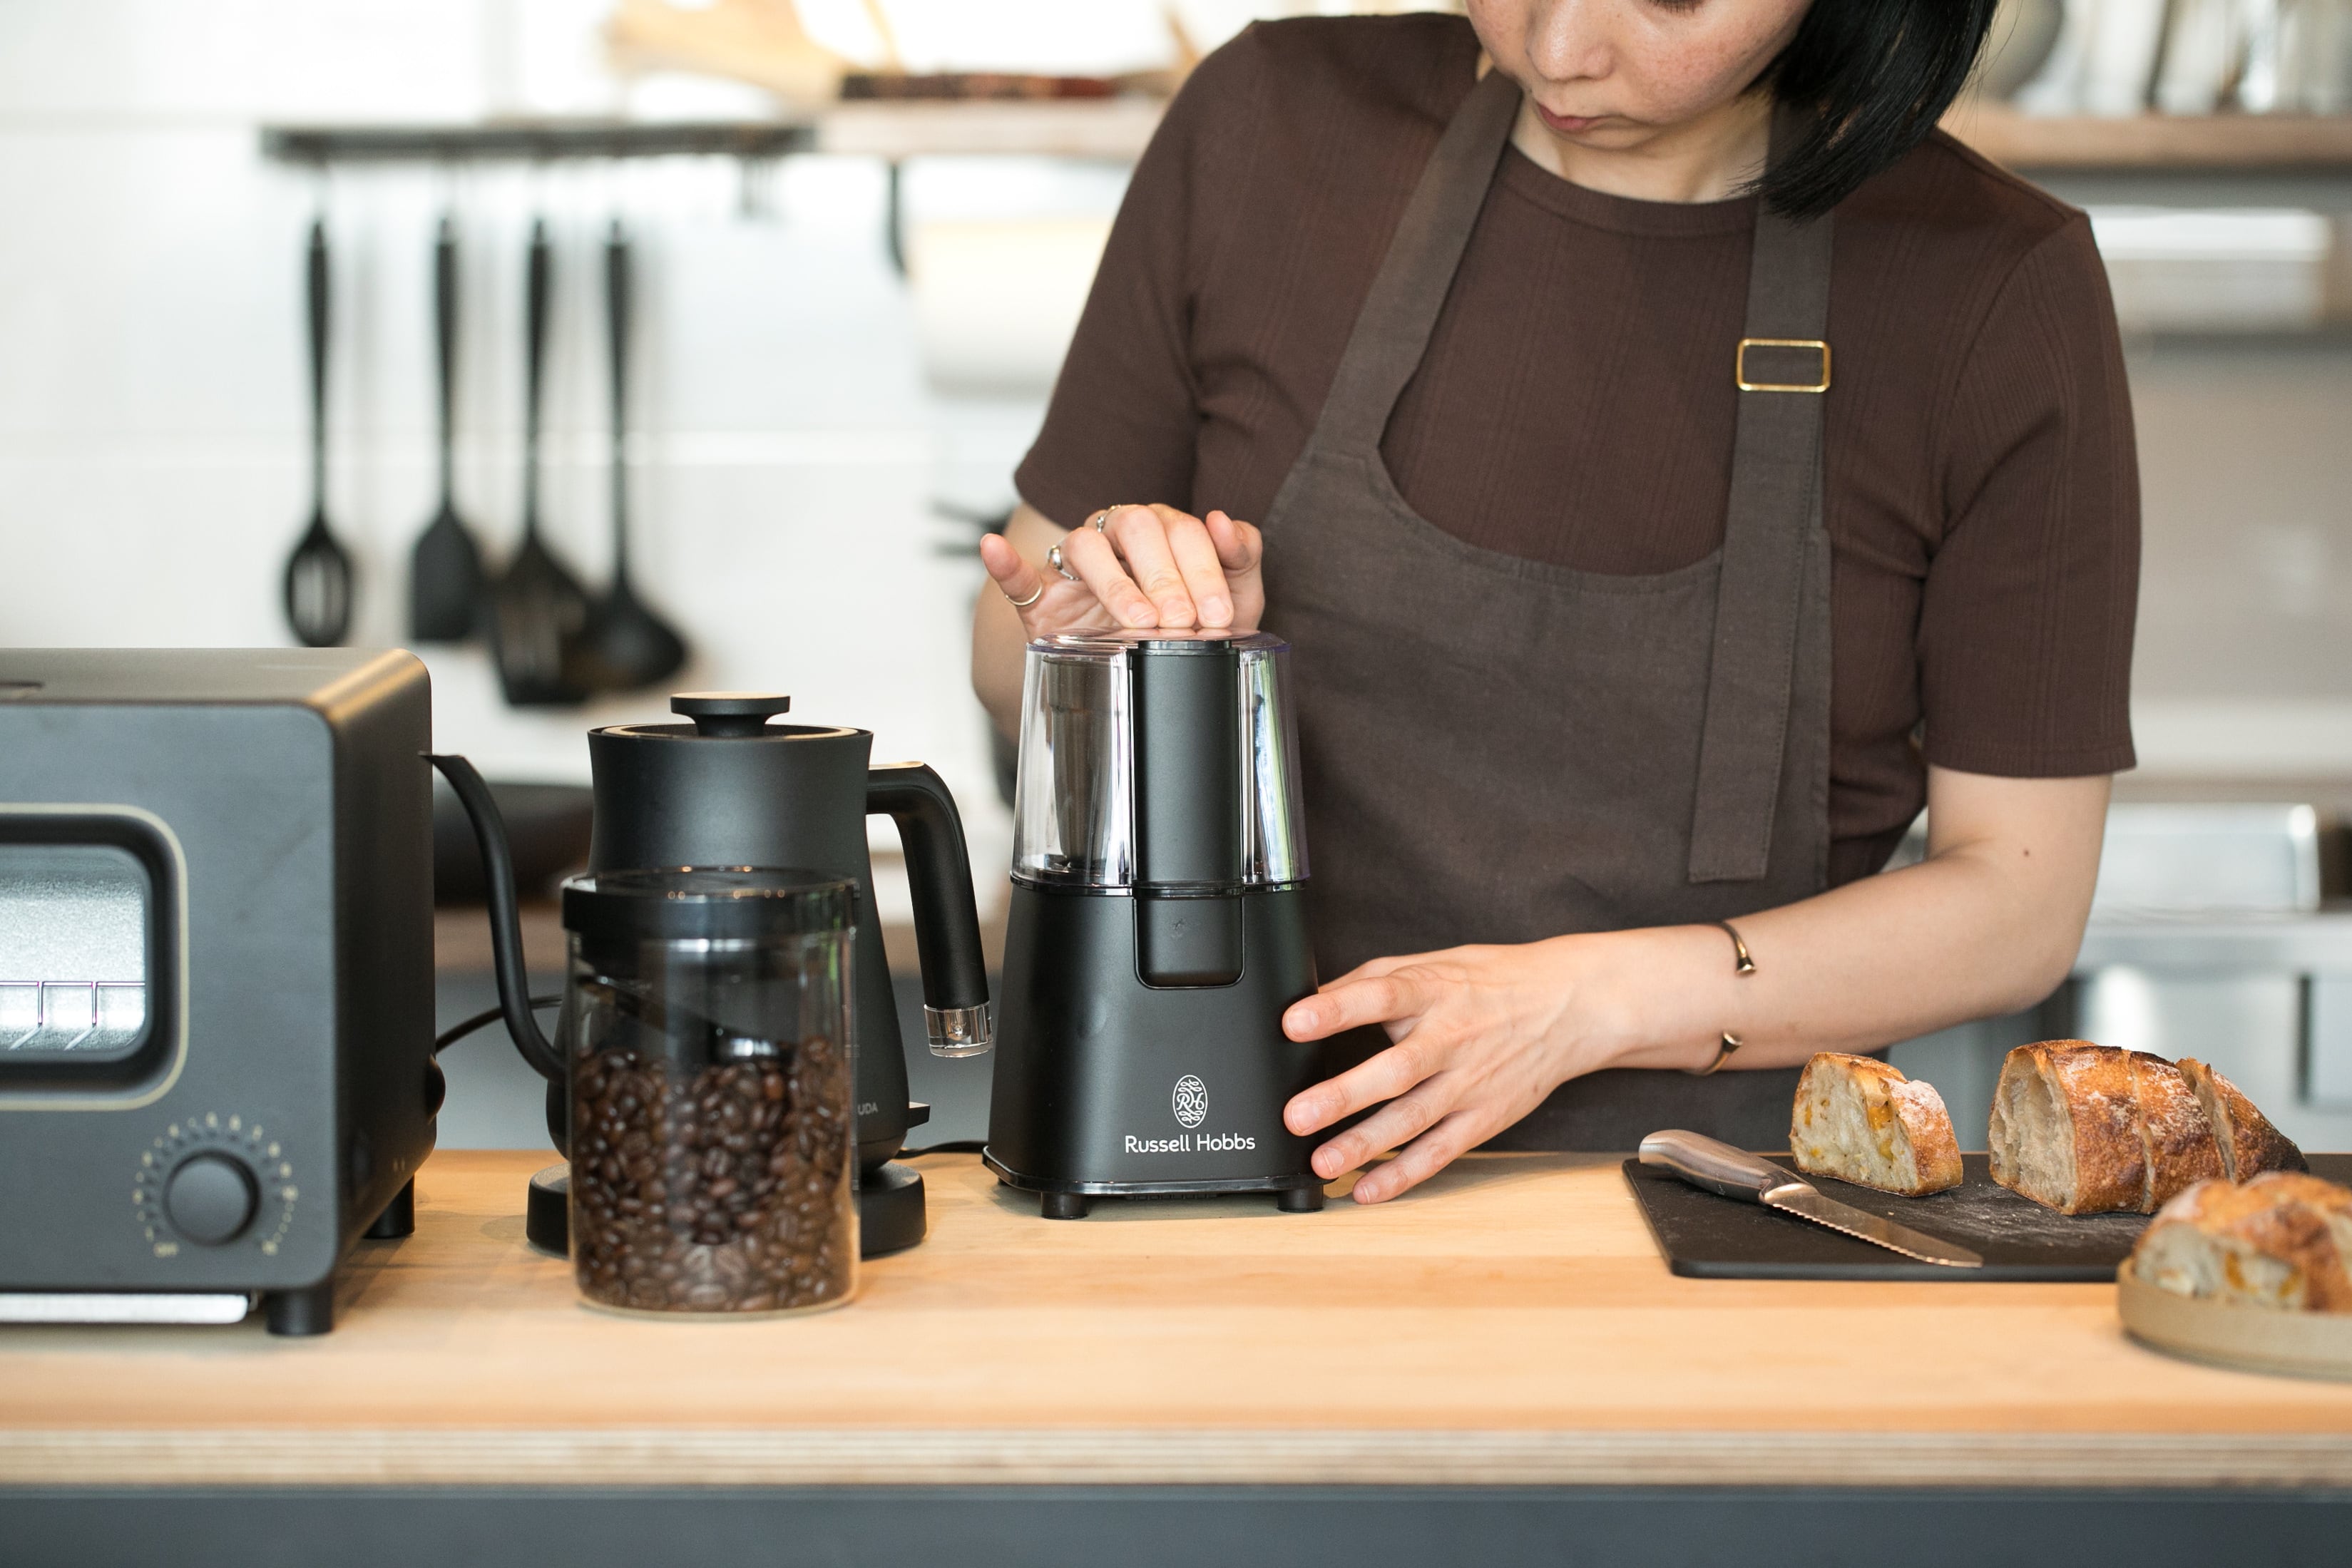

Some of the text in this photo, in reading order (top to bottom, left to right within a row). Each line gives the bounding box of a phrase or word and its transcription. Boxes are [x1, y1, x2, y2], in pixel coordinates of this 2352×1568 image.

[857, 1102, 879, 1115] UDA
[1125, 1132, 1256, 1153] Russell Hobbs
